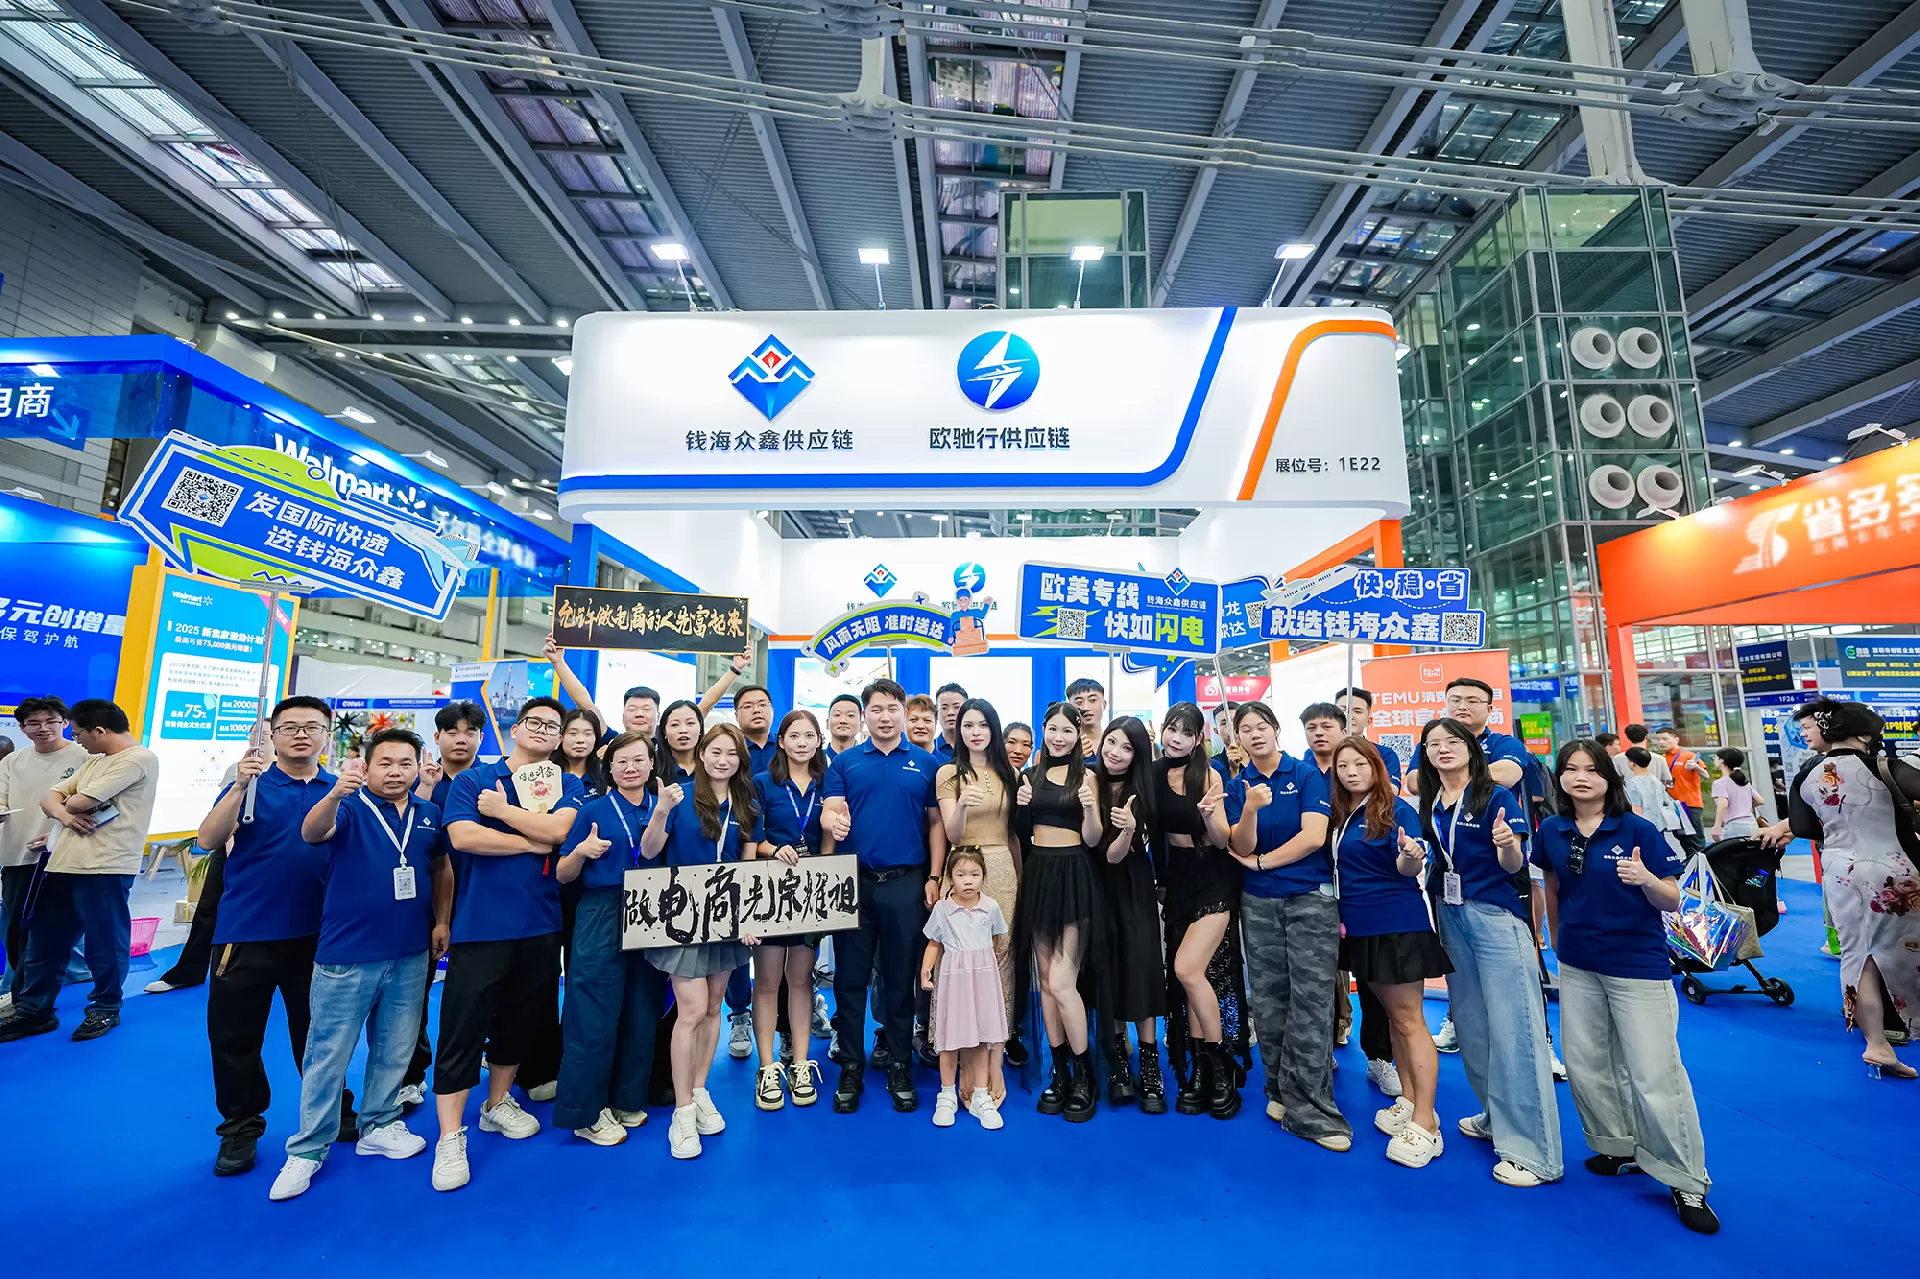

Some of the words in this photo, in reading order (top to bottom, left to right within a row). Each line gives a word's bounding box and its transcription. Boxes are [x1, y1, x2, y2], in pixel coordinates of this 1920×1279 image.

[686, 429, 854, 452] 钱海众鑫供应链
[929, 426, 1070, 450] 欧驰行供应链
[245, 490, 390, 558] 发国际快递
[264, 524, 405, 591] 选钱海众鑫
[172, 591, 203, 603] Walmart
[1040, 572, 1140, 610] 欧美专线
[1147, 595, 1206, 610] 钱海众鑫供应链
[0, 626, 79, 649] 保驾护航
[175, 623, 200, 635] 2025
[823, 614, 881, 654] 风雨无阻
[884, 614, 945, 640] 准时送达
[1104, 610, 1204, 646] 快如闪电
[1270, 609, 1440, 642] 就选钱海众鑫
[1371, 691, 1419, 705] TEMU
